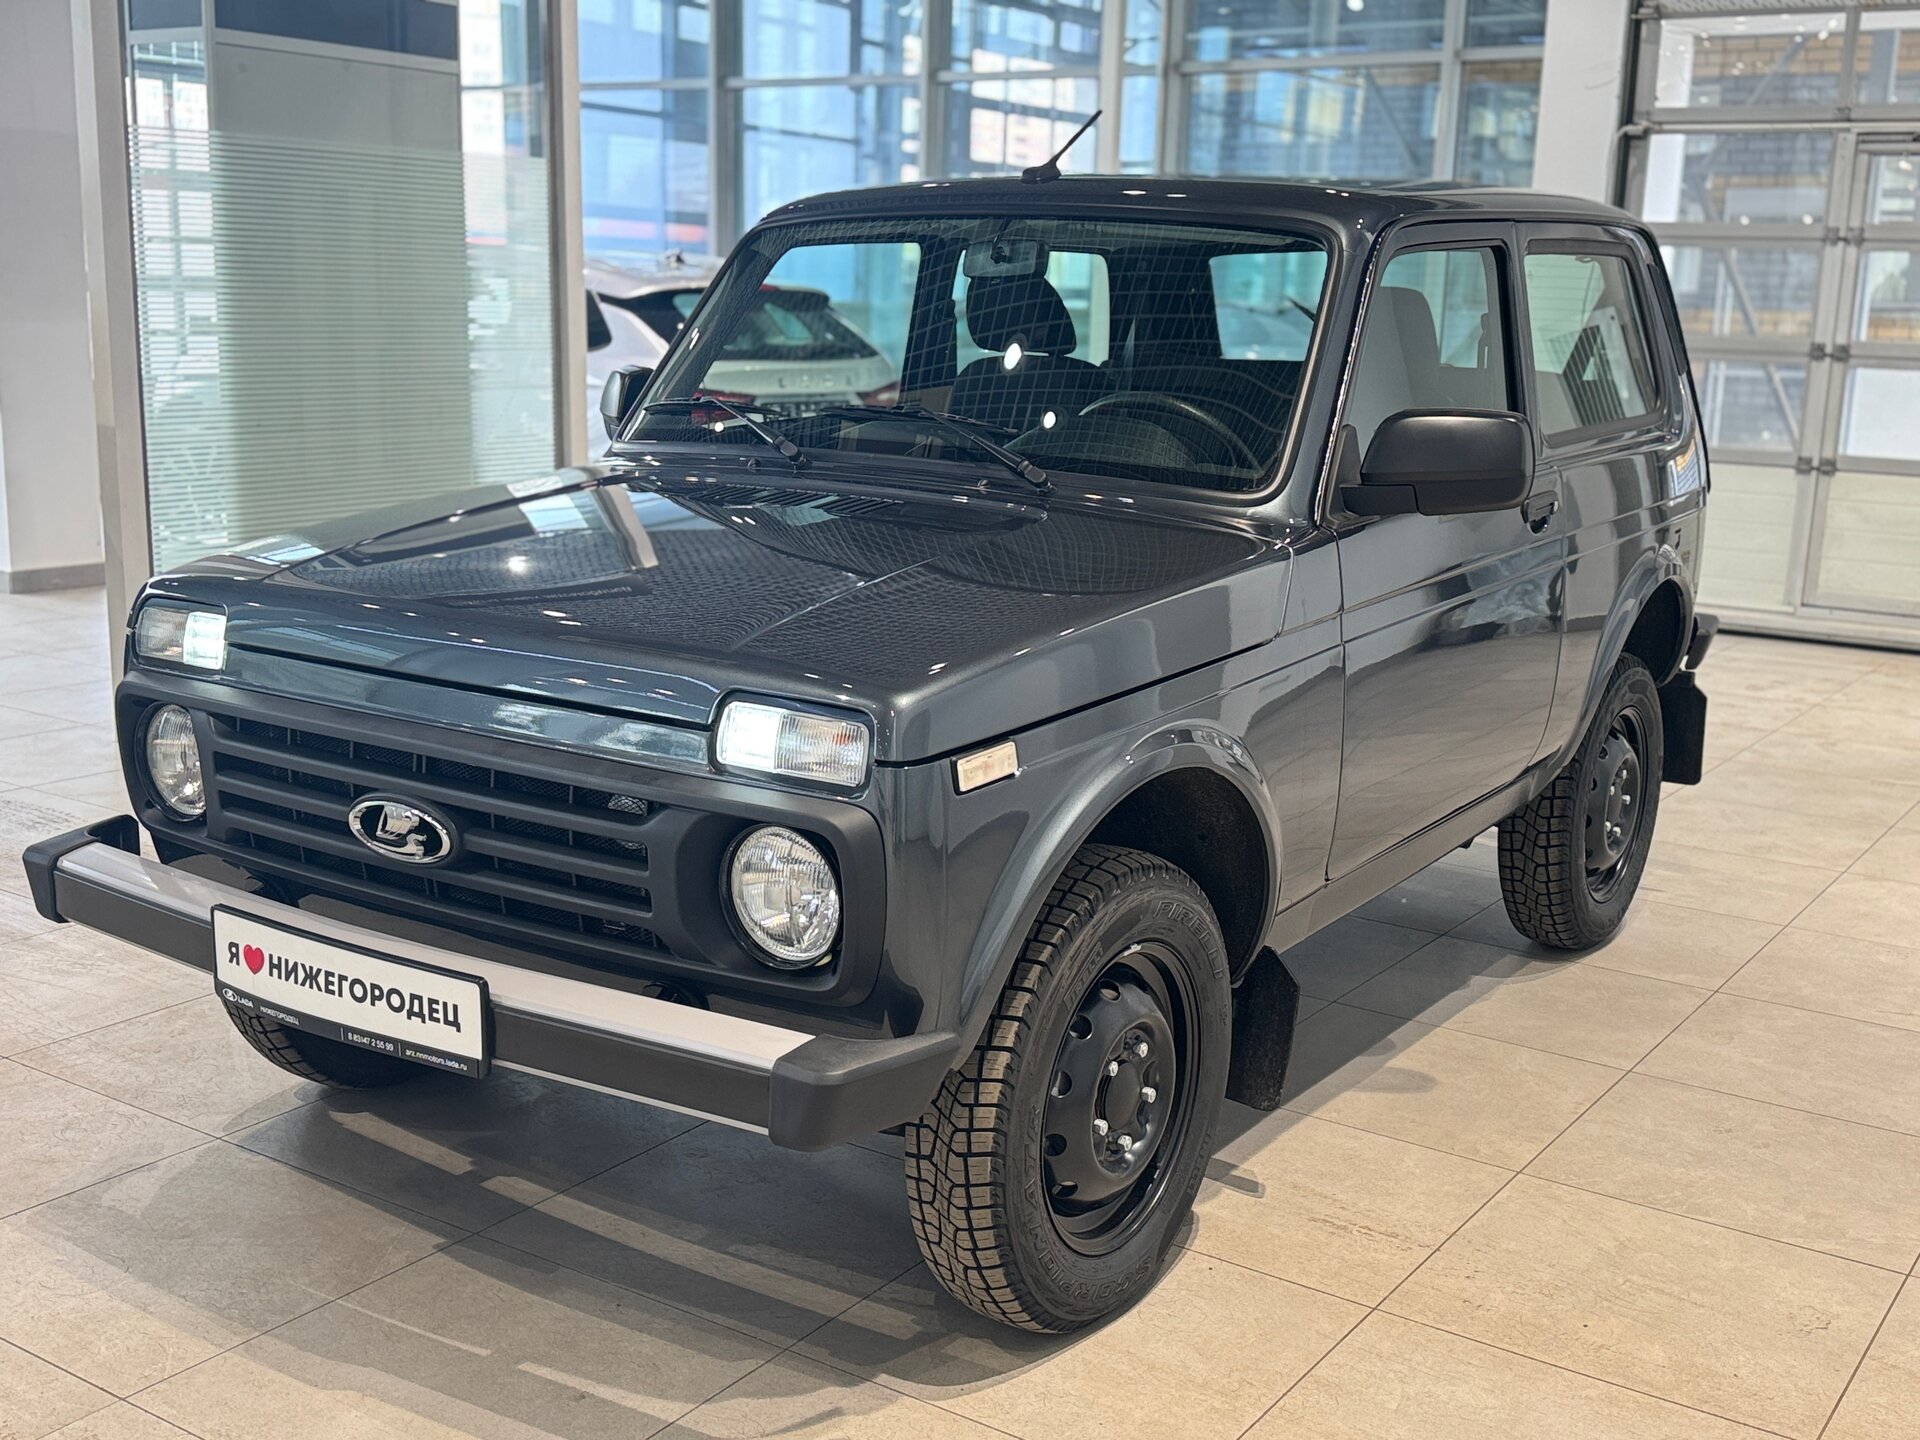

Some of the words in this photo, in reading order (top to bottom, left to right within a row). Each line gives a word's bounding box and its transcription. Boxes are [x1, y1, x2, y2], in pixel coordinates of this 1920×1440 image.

[1153, 900, 1224, 981] PIRELLI
[228, 941, 240, 966] Я
[268, 953, 462, 1033] НИЖЕГОРОДЕЦ
[237, 995, 254, 1009] LADA
[259, 1005, 300, 1026] НИЖЕГОРОДЕЦ
